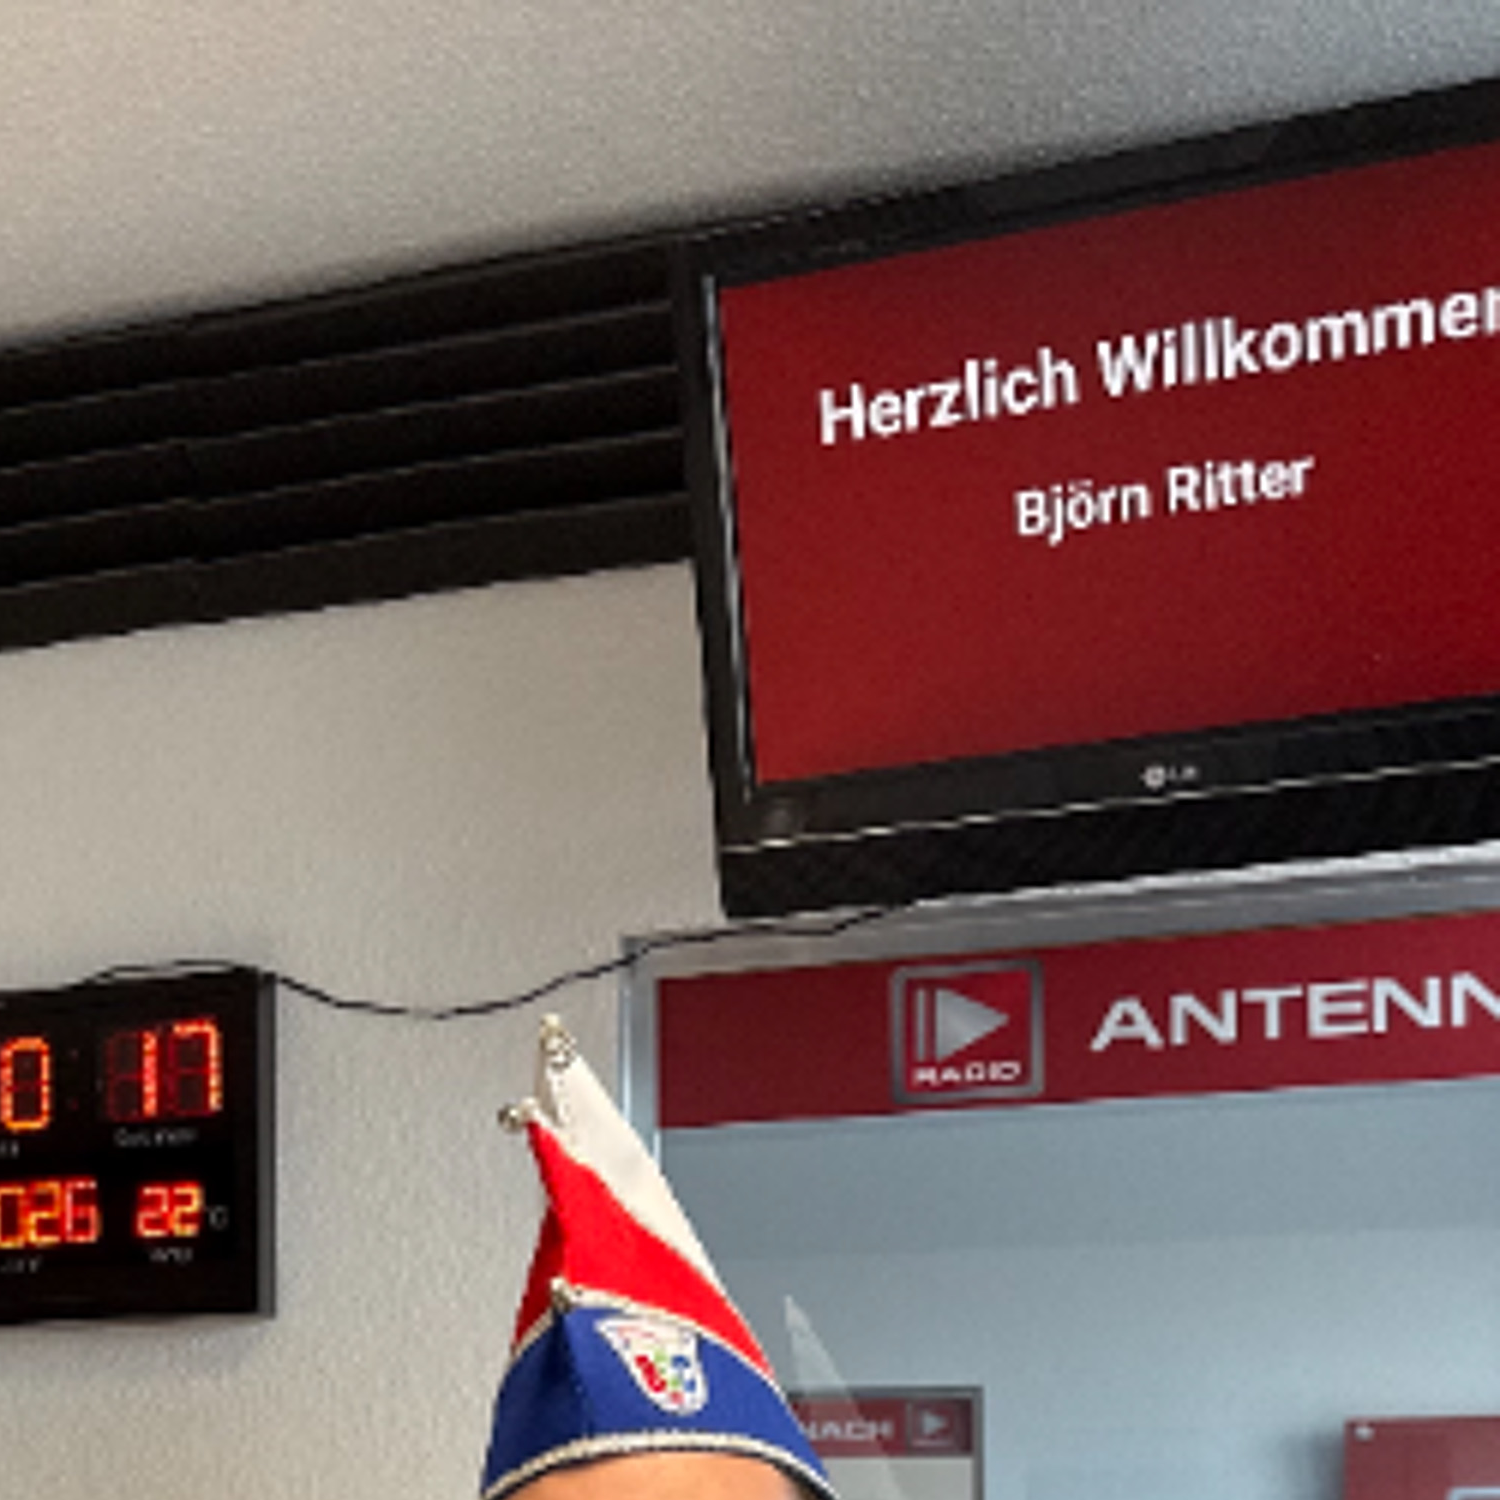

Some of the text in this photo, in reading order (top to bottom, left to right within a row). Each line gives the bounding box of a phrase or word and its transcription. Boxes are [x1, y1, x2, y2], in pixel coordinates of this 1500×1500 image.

[819, 346, 1080, 446] Herzlich
[1015, 455, 1314, 546] Björn Ritter
[140, 1017, 222, 1117] 17
[136, 1184, 203, 1238] 22
